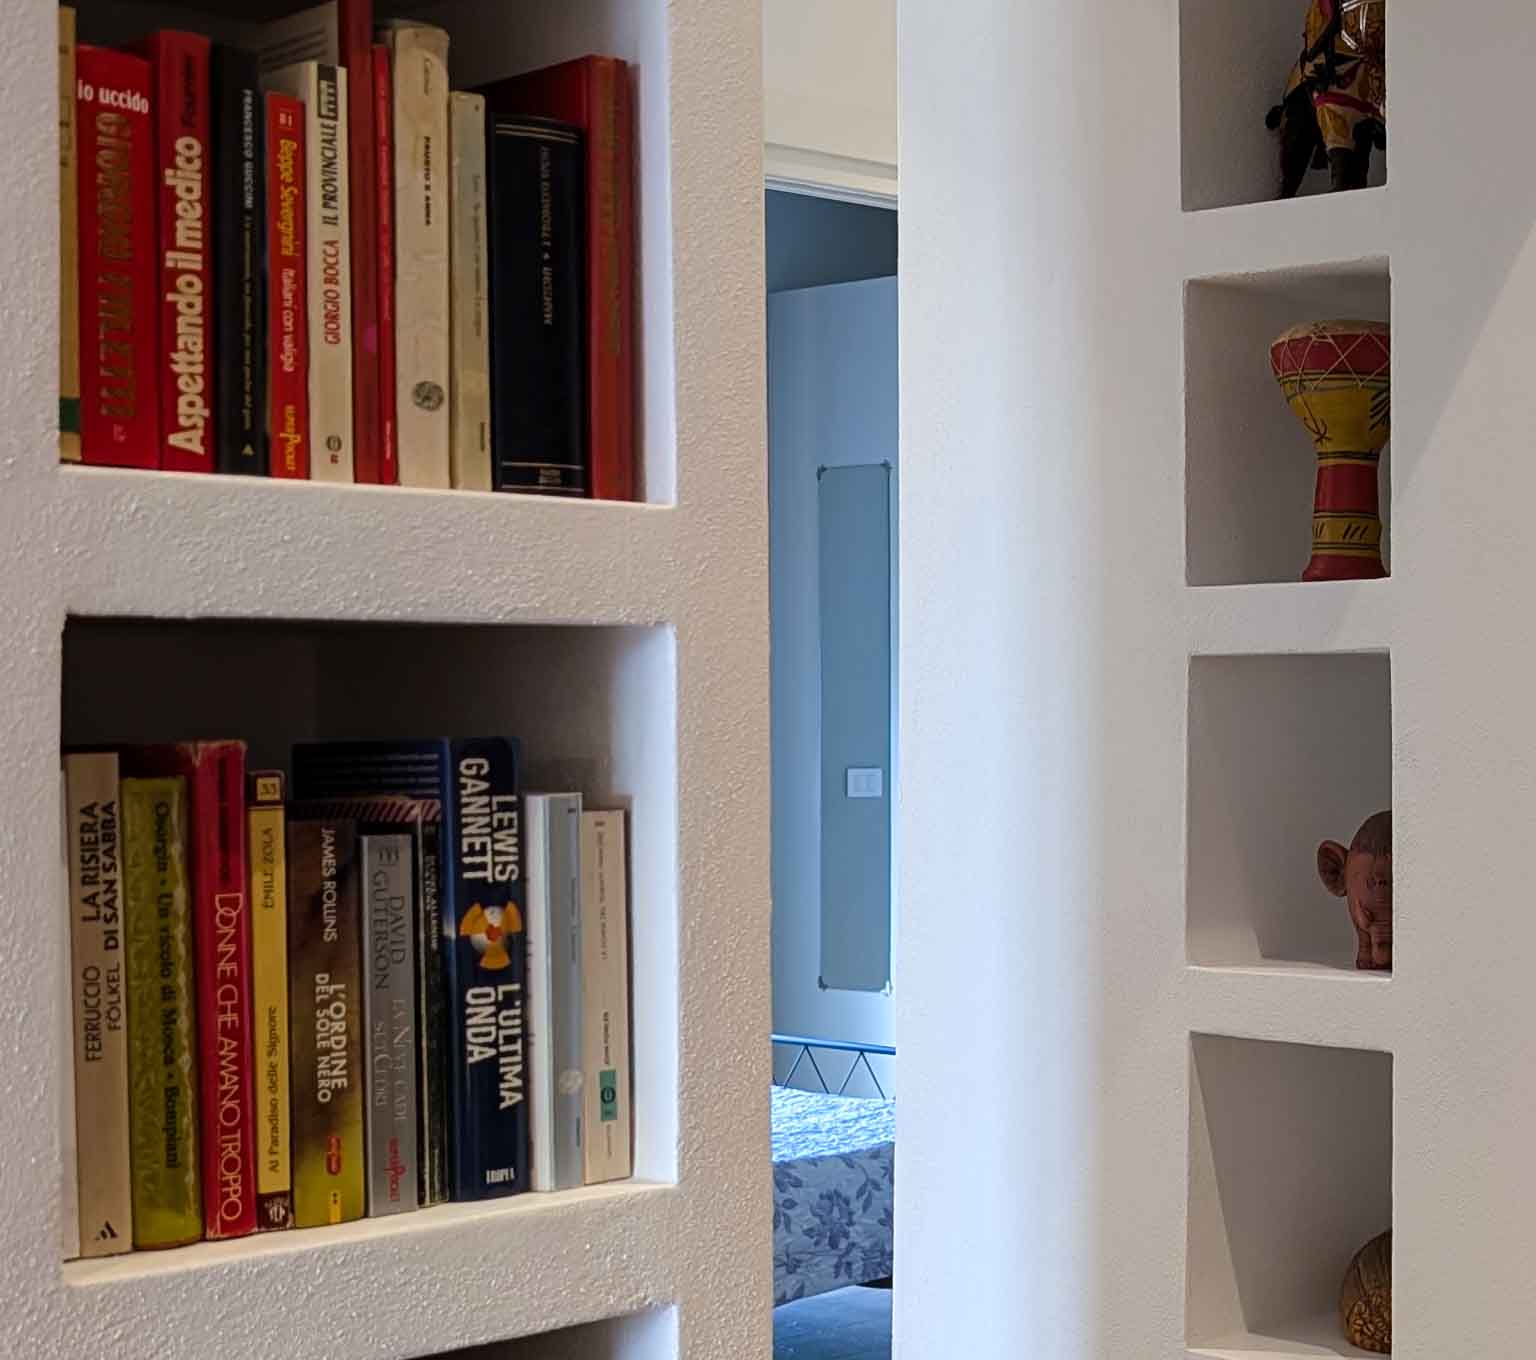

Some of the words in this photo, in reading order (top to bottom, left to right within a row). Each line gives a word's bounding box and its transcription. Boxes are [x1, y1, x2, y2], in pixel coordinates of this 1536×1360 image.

[99, 86, 149, 114] uccido
[243, 88, 255, 159] FRANCESCO
[278, 138, 298, 183] Beppe
[319, 120, 338, 211] PROVINCIALE
[163, 136, 204, 249] medico
[279, 185, 300, 257] Severgnini
[321, 213, 338, 226] IL
[163, 250, 204, 271] il
[282, 268, 298, 308] Italiani
[322, 239, 340, 287] BOCCA
[283, 309, 295, 333] con
[323, 288, 342, 345] GIORGIO
[165, 274, 210, 455] Aspettando
[279, 334, 297, 373] valigia
[80, 800, 100, 888] RISIERA
[261, 826, 274, 865] ZOLA
[459, 756, 493, 884] GANNETT
[491, 795, 519, 882] LEWIS
[321, 827, 337, 878] JAMES
[81, 891, 100, 923] LA
[102, 878, 118, 925] SAN
[321, 880, 338, 943] ROLLINS
[389, 895, 406, 965] DAVID
[103, 928, 119, 952] DI
[215, 892, 244, 977] DONNE
[82, 965, 102, 1063] FERRUCCIO
[216, 984, 241, 1031] CHE
[315, 972, 331, 1004] DEL
[315, 1007, 332, 1050] SOLE
[329, 983, 348, 1091] L'ORDINE
[465, 985, 497, 1064] ONDA
[497, 982, 524, 1111] L'ULTIMA
[216, 1037, 242, 1127] AMANO
[316, 1055, 333, 1104] NERO
[219, 1127, 243, 1221] TROPPO
